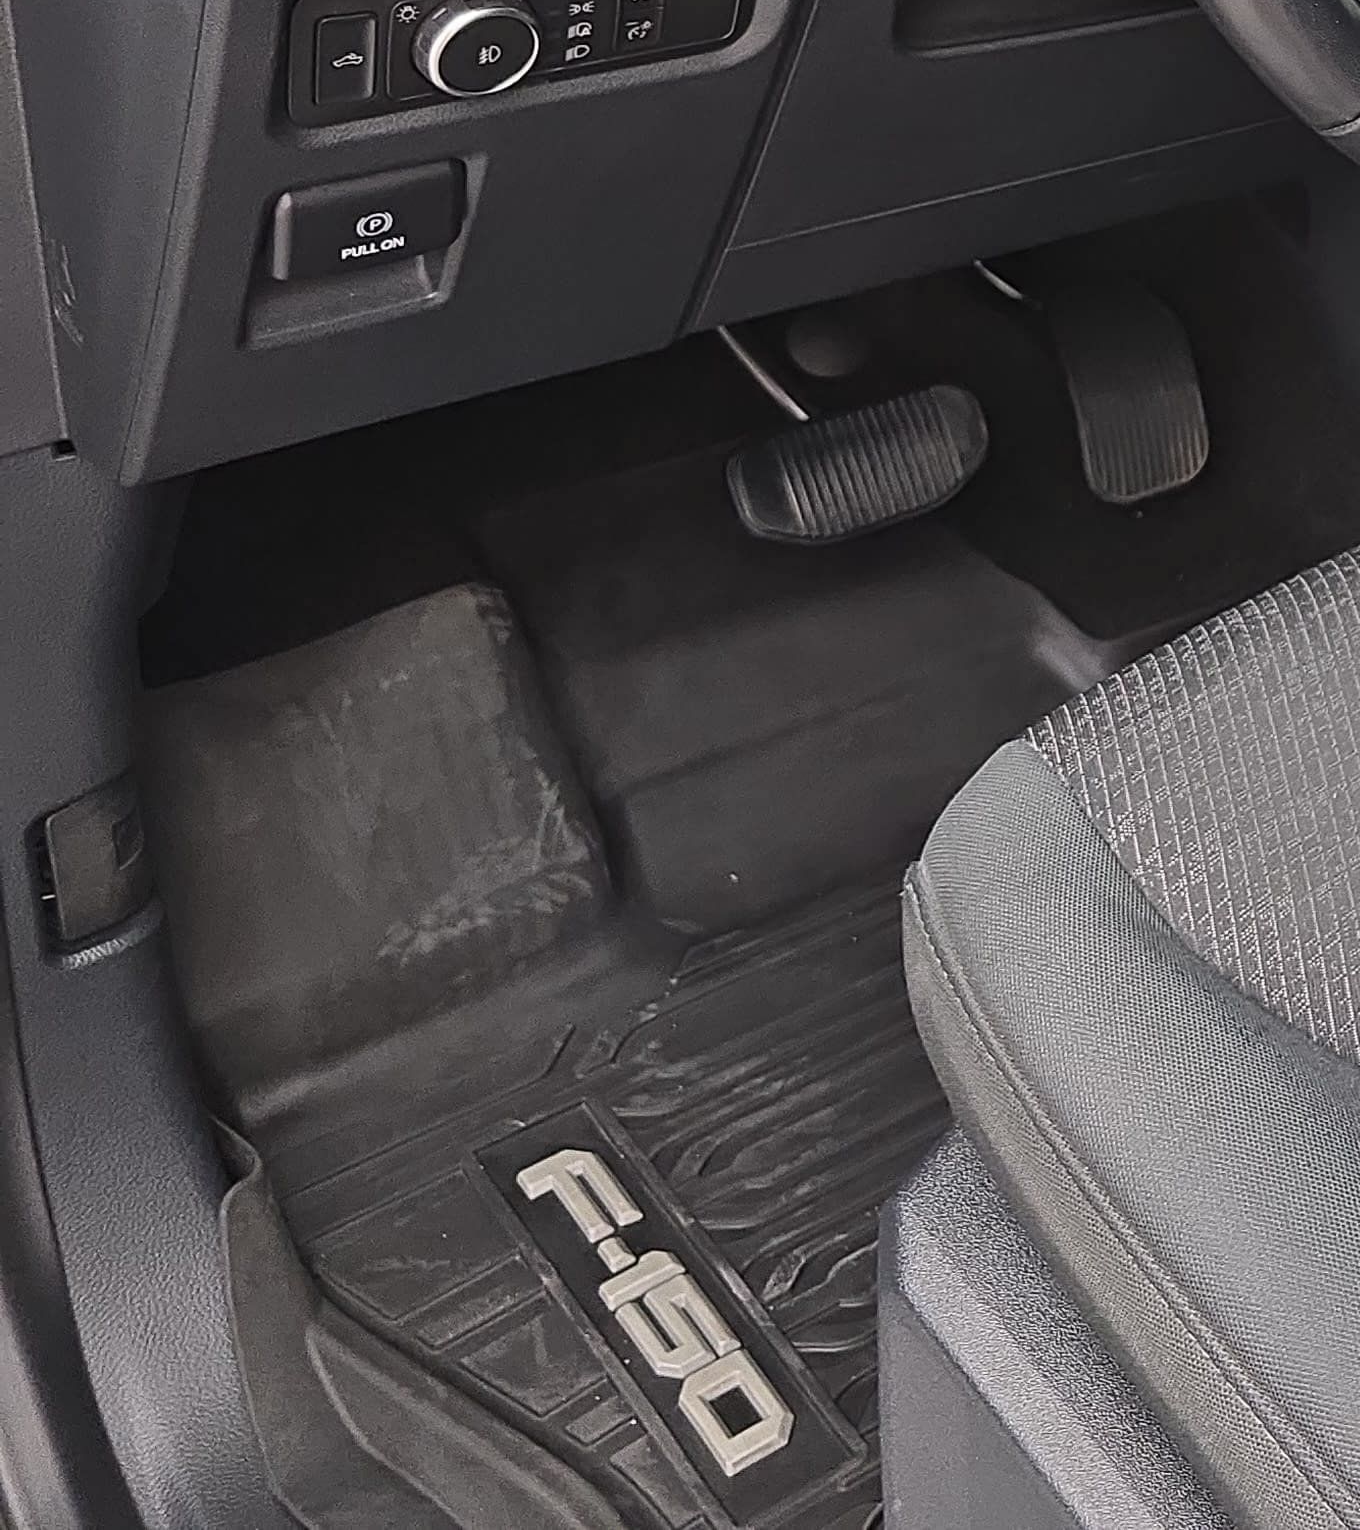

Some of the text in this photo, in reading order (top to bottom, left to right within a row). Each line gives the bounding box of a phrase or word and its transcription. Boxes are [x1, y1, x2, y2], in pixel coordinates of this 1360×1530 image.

[341, 236, 405, 260] PULL ON
[517, 1149, 795, 1478] F-150
